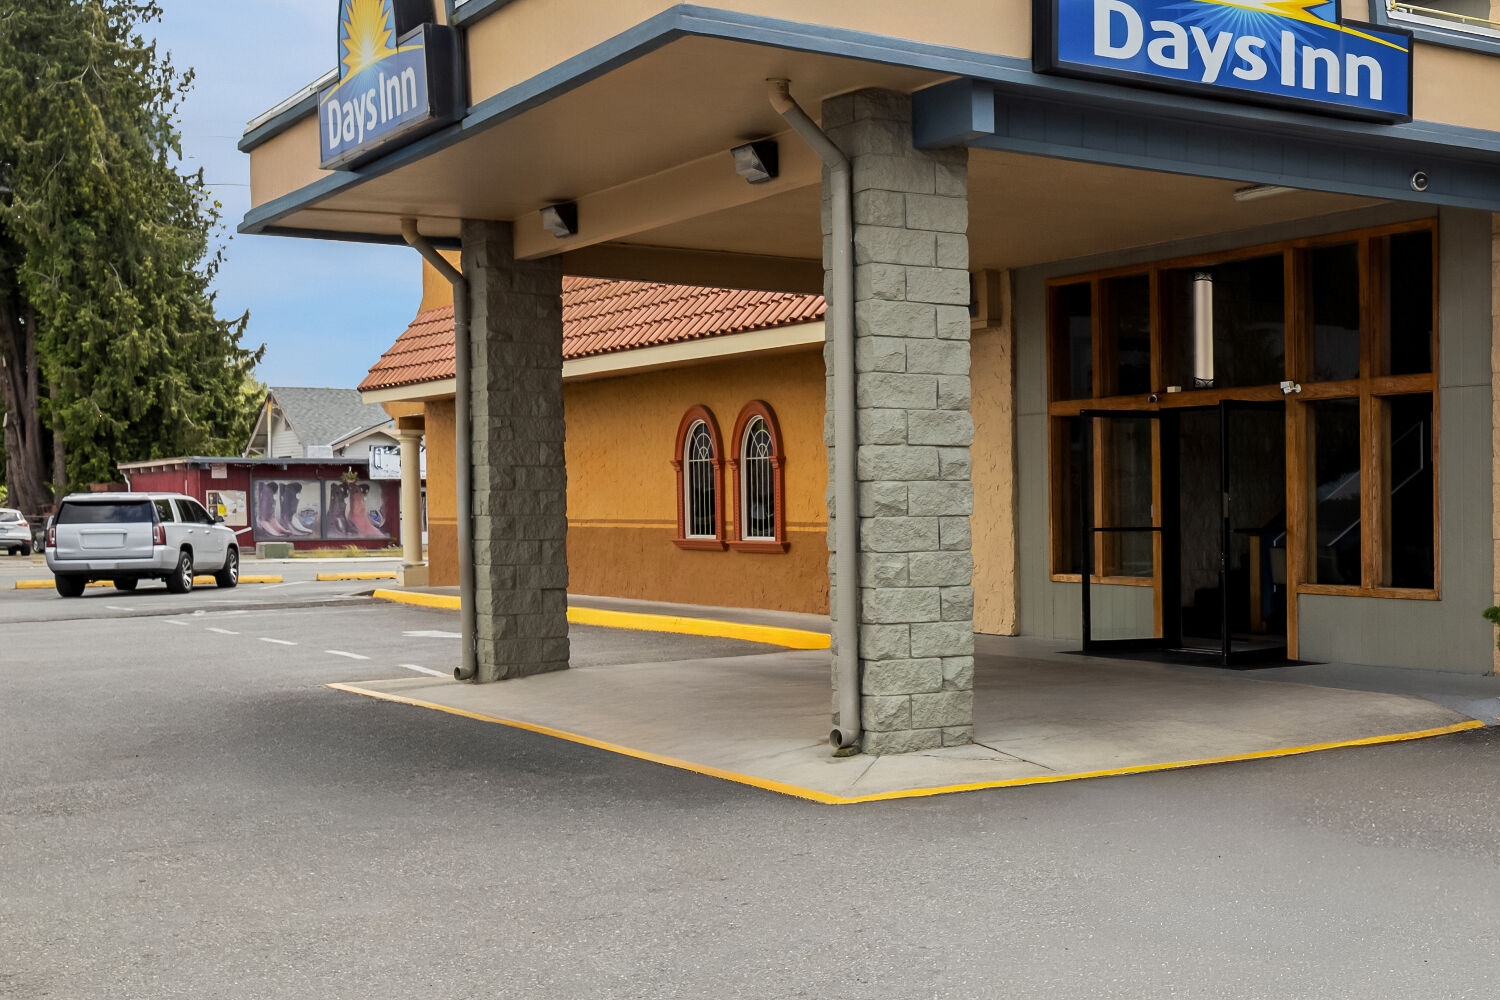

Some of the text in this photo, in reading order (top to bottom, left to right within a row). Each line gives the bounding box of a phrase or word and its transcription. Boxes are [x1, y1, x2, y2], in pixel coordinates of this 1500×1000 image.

[1280, 30, 1383, 101] Inn
[327, 66, 417, 150] Days Inn
